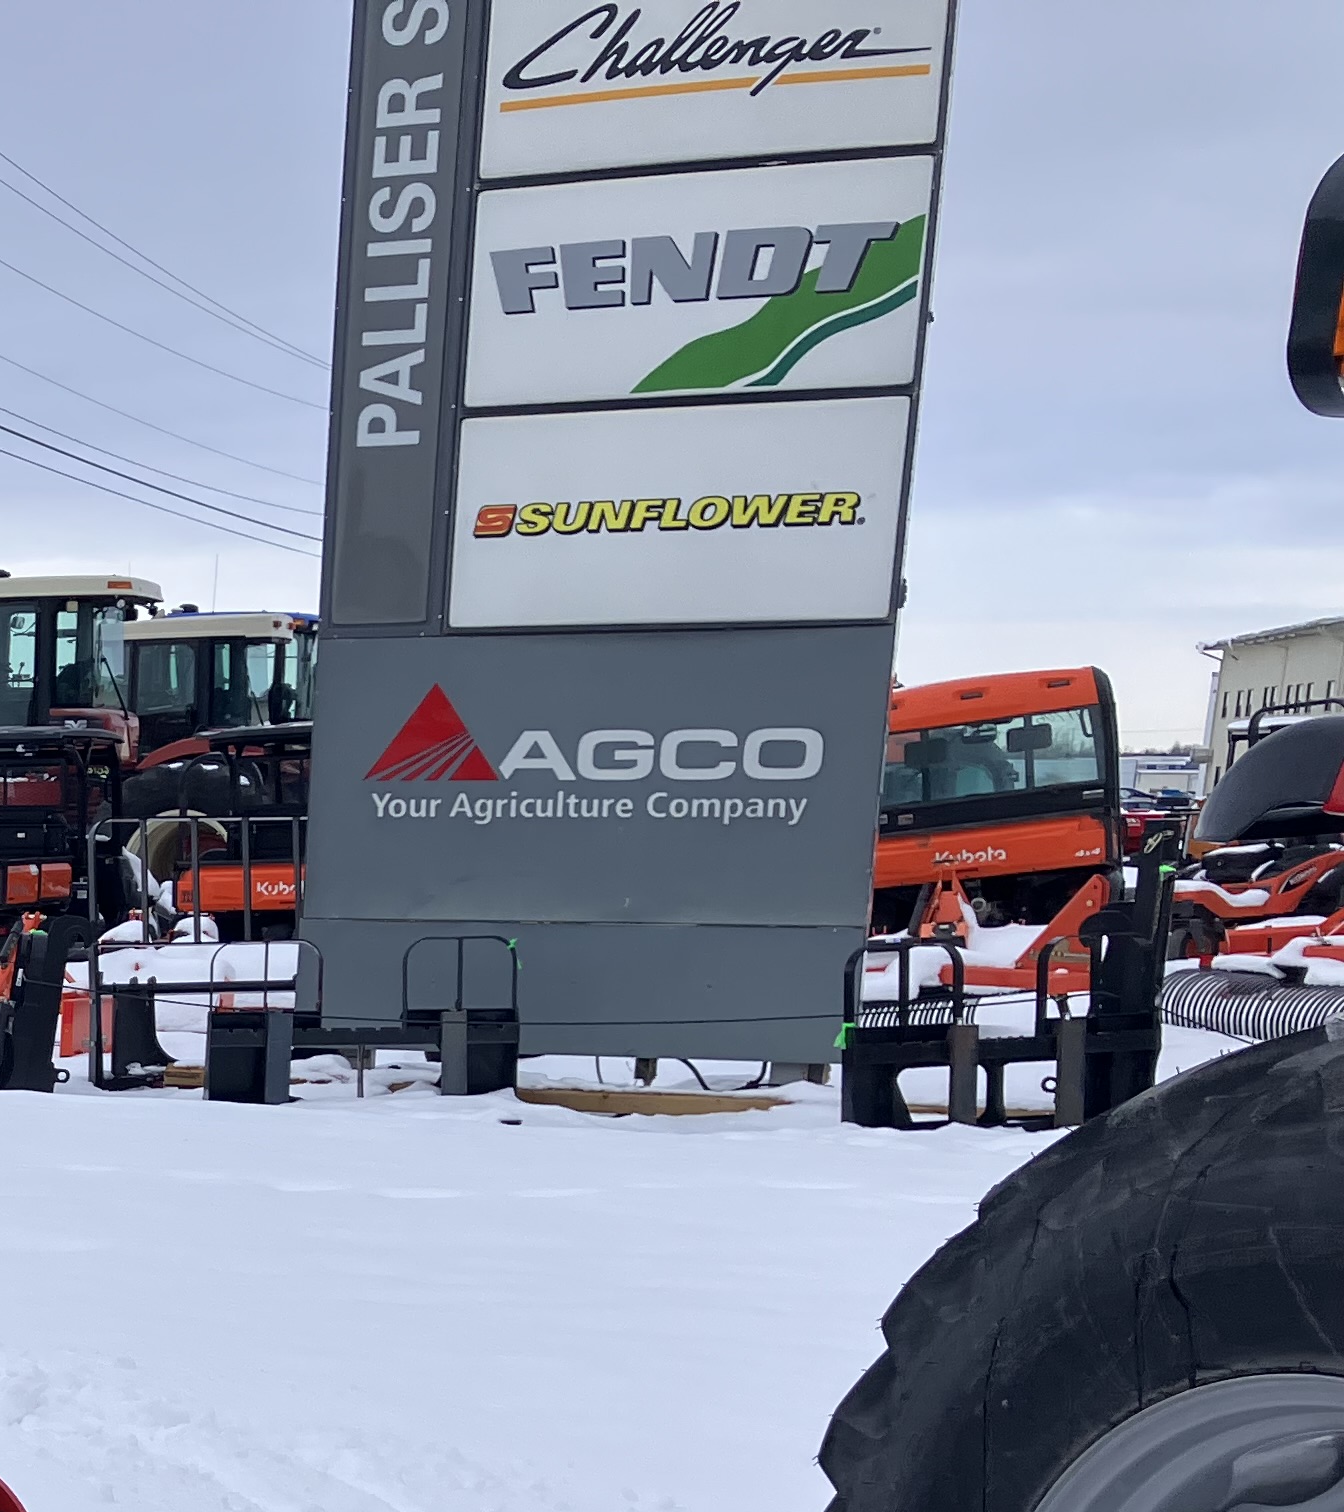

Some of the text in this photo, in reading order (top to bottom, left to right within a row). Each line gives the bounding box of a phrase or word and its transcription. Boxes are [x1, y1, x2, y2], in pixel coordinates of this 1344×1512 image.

[502, 1, 932, 96] Challenger
[356, 73, 444, 447] PALLISER
[489, 221, 900, 315] FENDT
[516, 491, 861, 535] SUNFLOWER
[498, 728, 824, 781] AGCO
[371, 790, 808, 825] Your Agriculture Company
[935, 846, 1007, 867] Kubota
